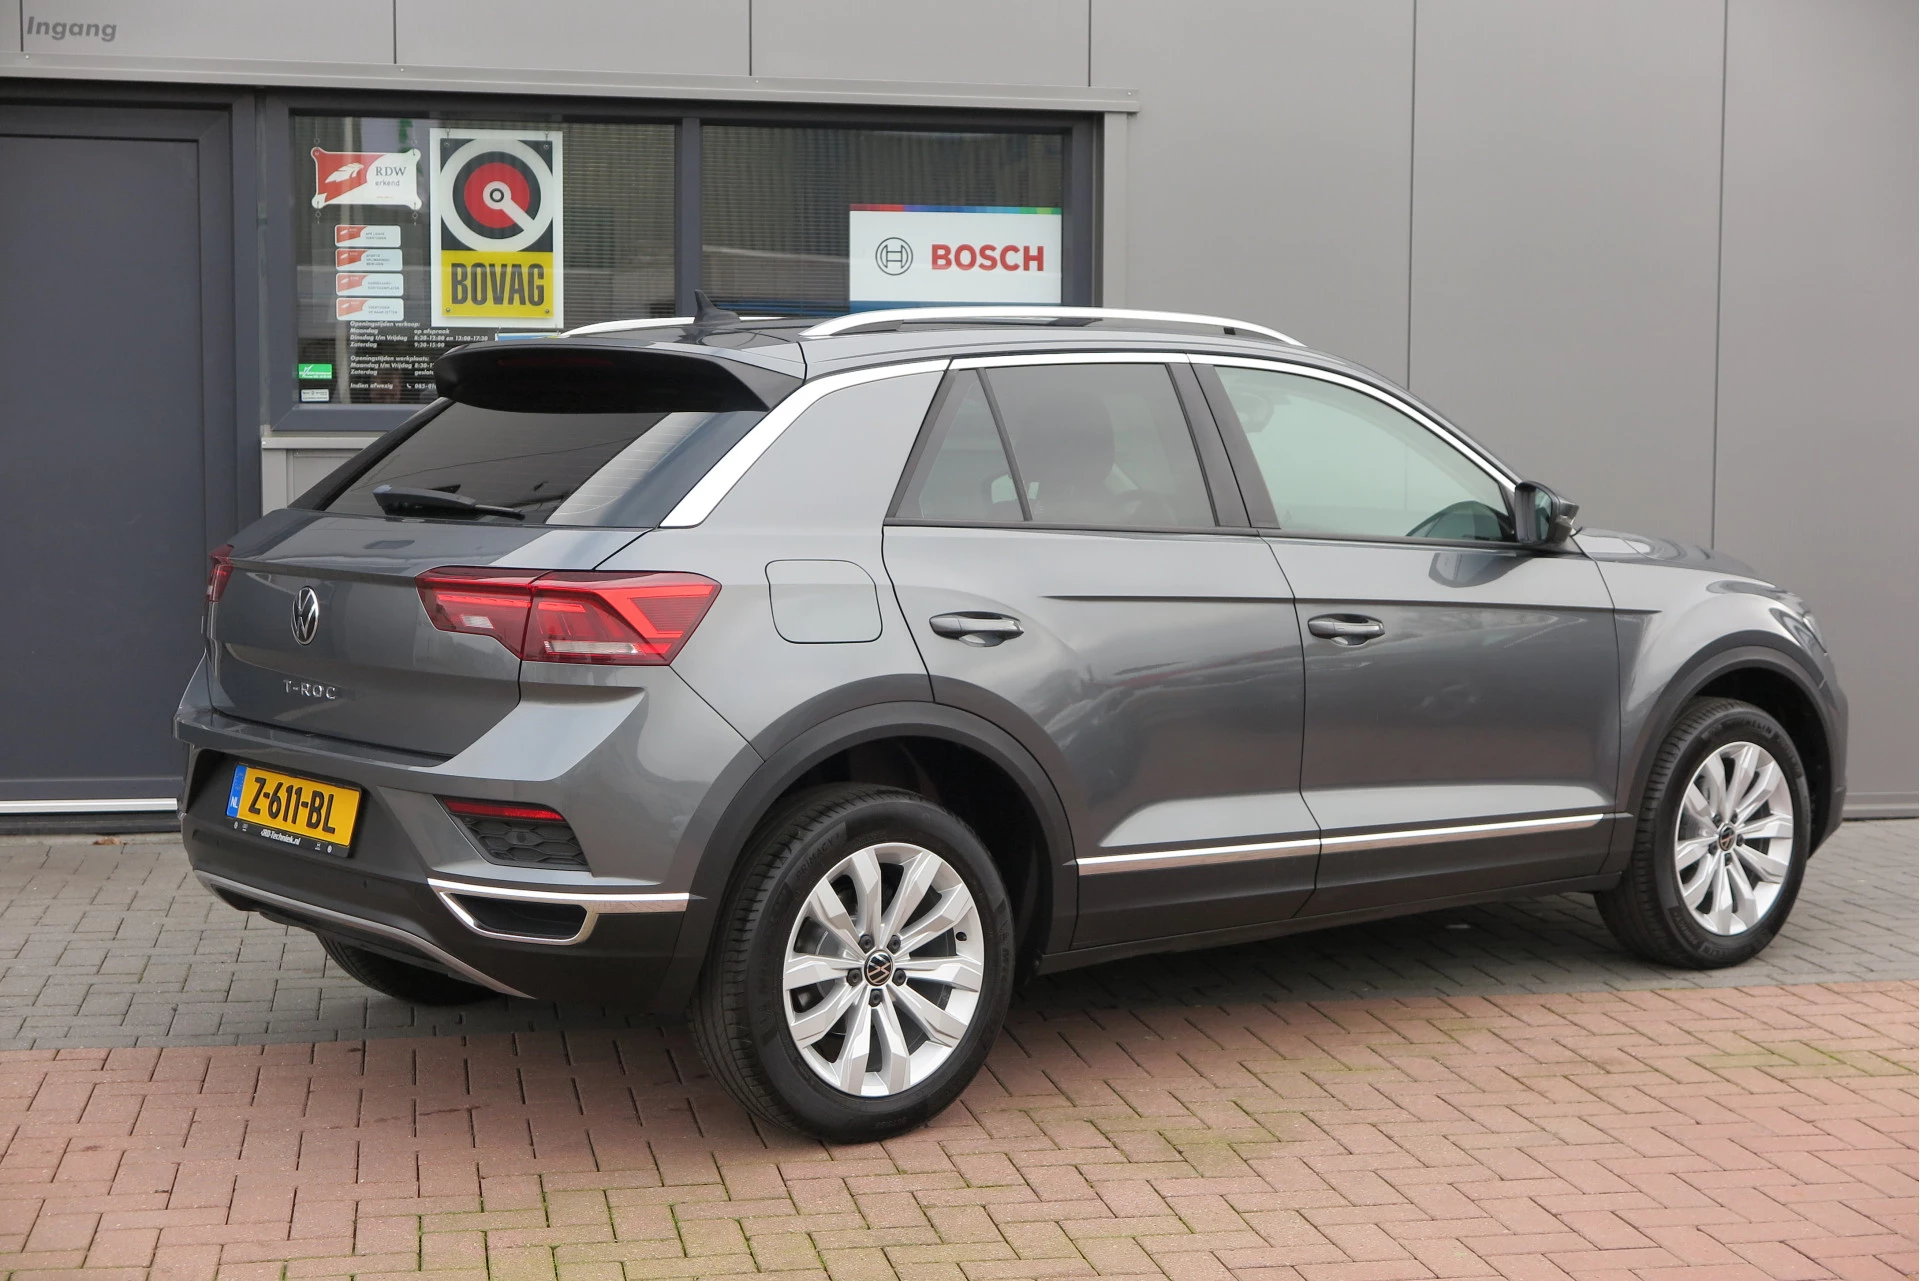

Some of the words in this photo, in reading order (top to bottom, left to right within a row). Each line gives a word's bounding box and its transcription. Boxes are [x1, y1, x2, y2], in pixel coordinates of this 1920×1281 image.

[26, 16, 117, 42] Ingang
[375, 166, 407, 176] RDW
[931, 243, 1044, 272] BOSCH
[451, 262, 545, 306] BOVAG
[283, 679, 336, 700] T-ROC
[230, 796, 238, 809] NL
[248, 776, 336, 834] Z-611-BL
